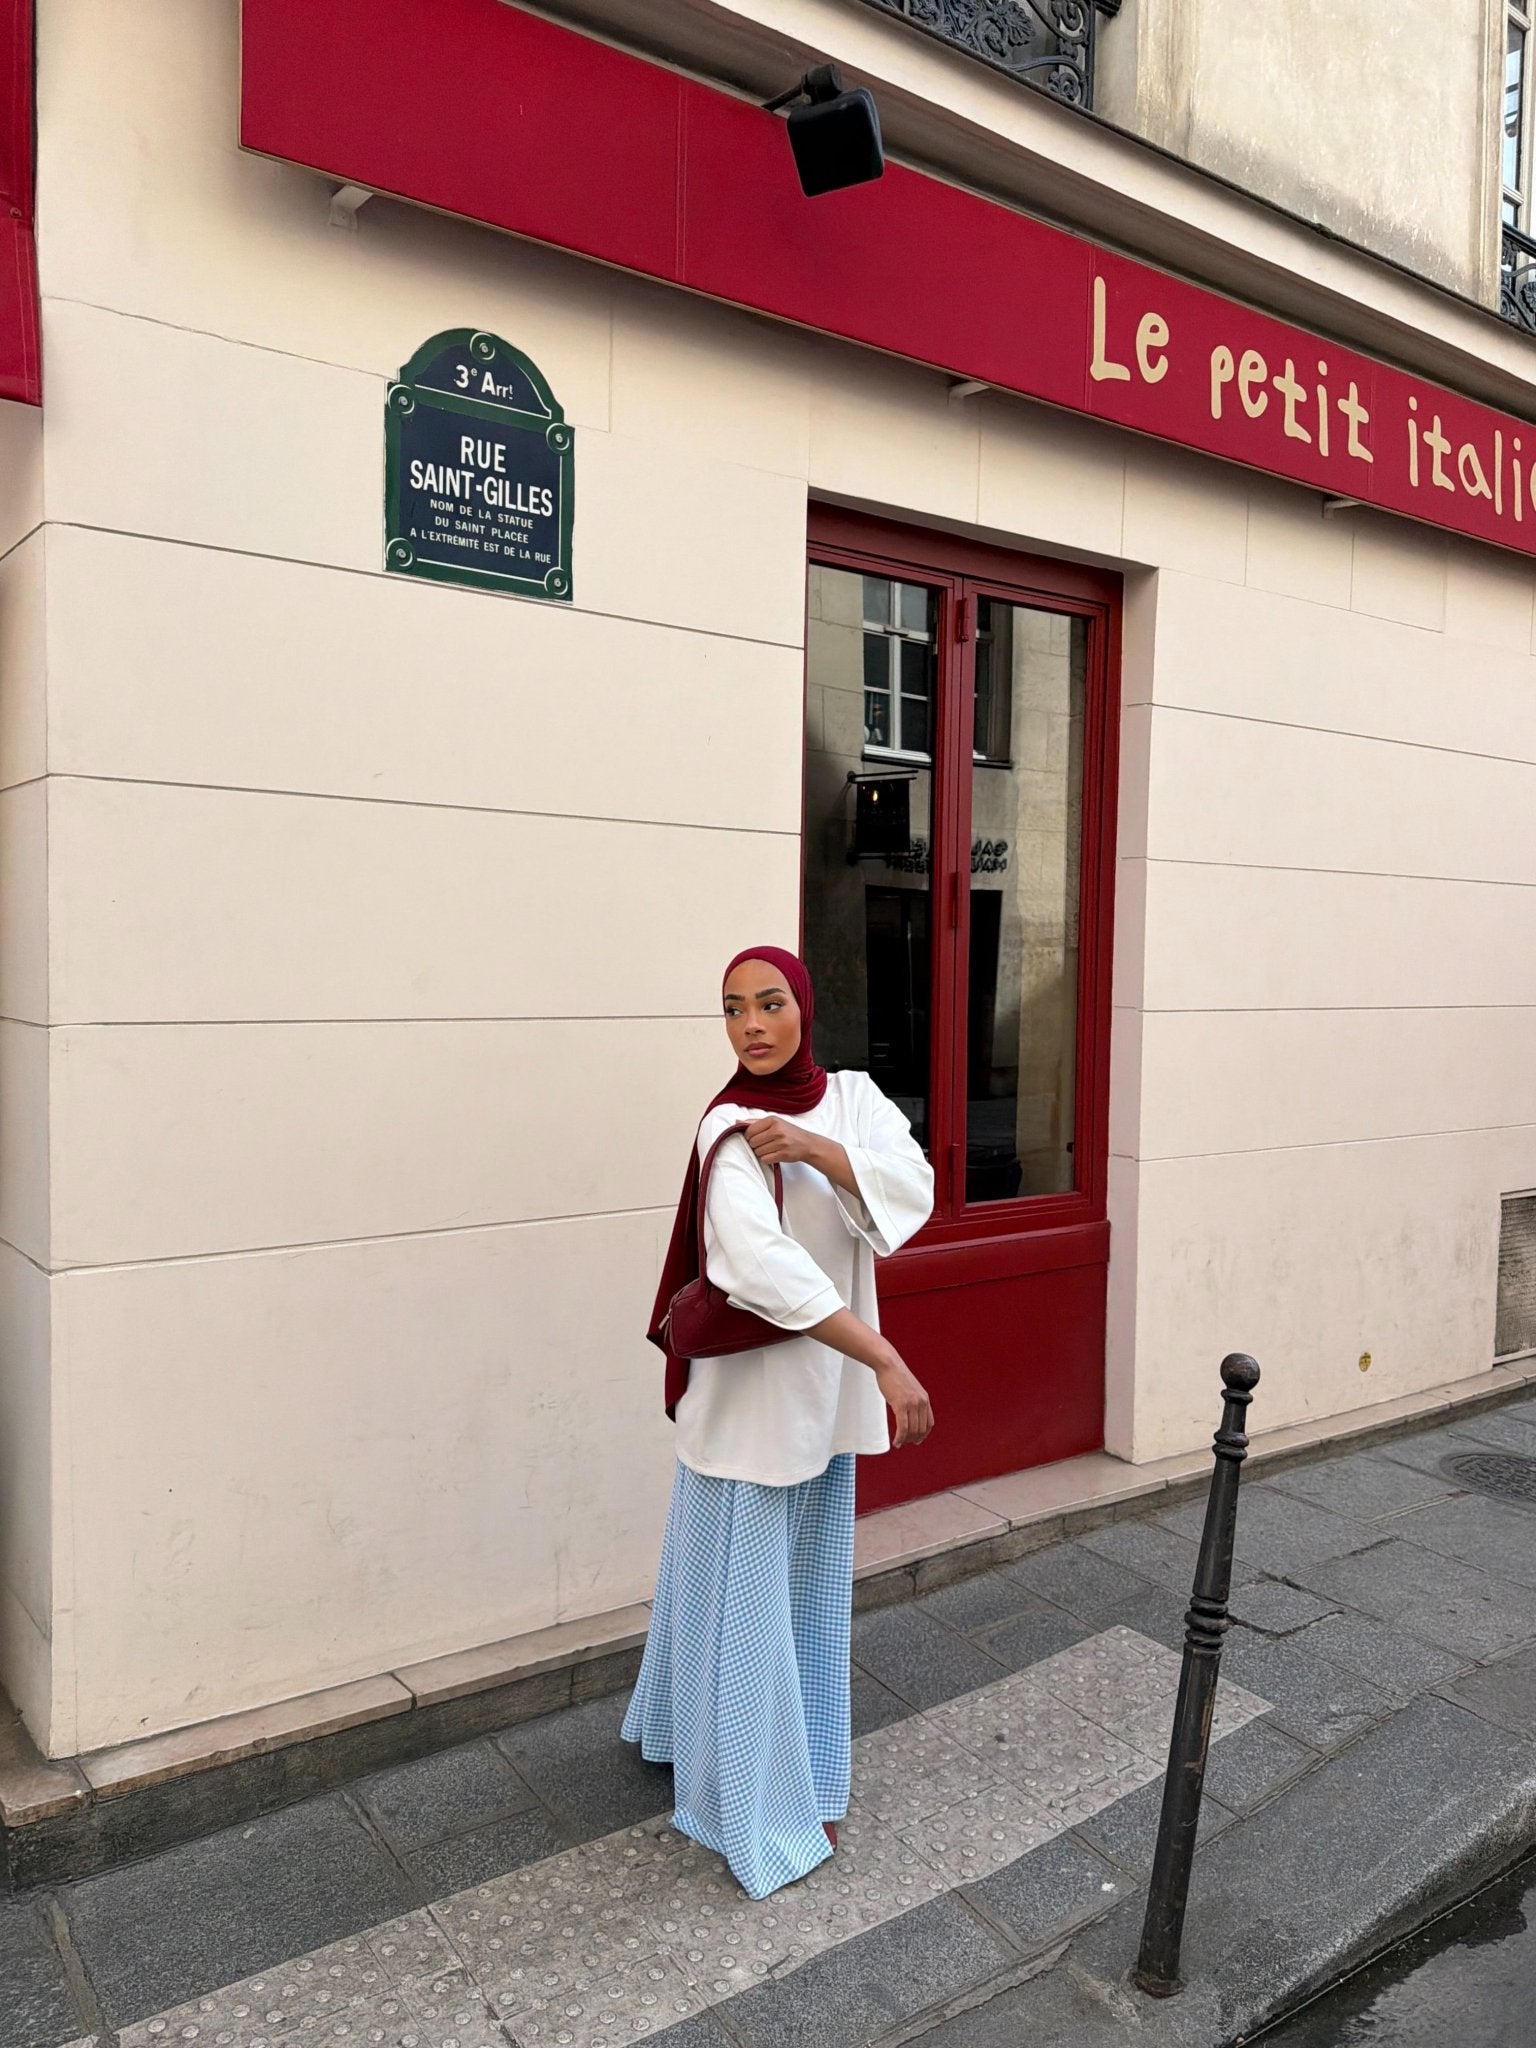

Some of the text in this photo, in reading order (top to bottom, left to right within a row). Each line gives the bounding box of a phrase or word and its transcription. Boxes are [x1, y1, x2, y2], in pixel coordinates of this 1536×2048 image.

[1090, 276, 1536, 522] Le petit itali
[460, 435, 507, 473] RUE
[410, 459, 553, 517] SAINT-GILLES
[430, 498, 534, 529] NOM DE LA STATUE
[435, 515, 529, 544] DU SAINT PLACÉE
[410, 527, 552, 564] A L'EXTRÉMITÉ EST DE LA RUE
